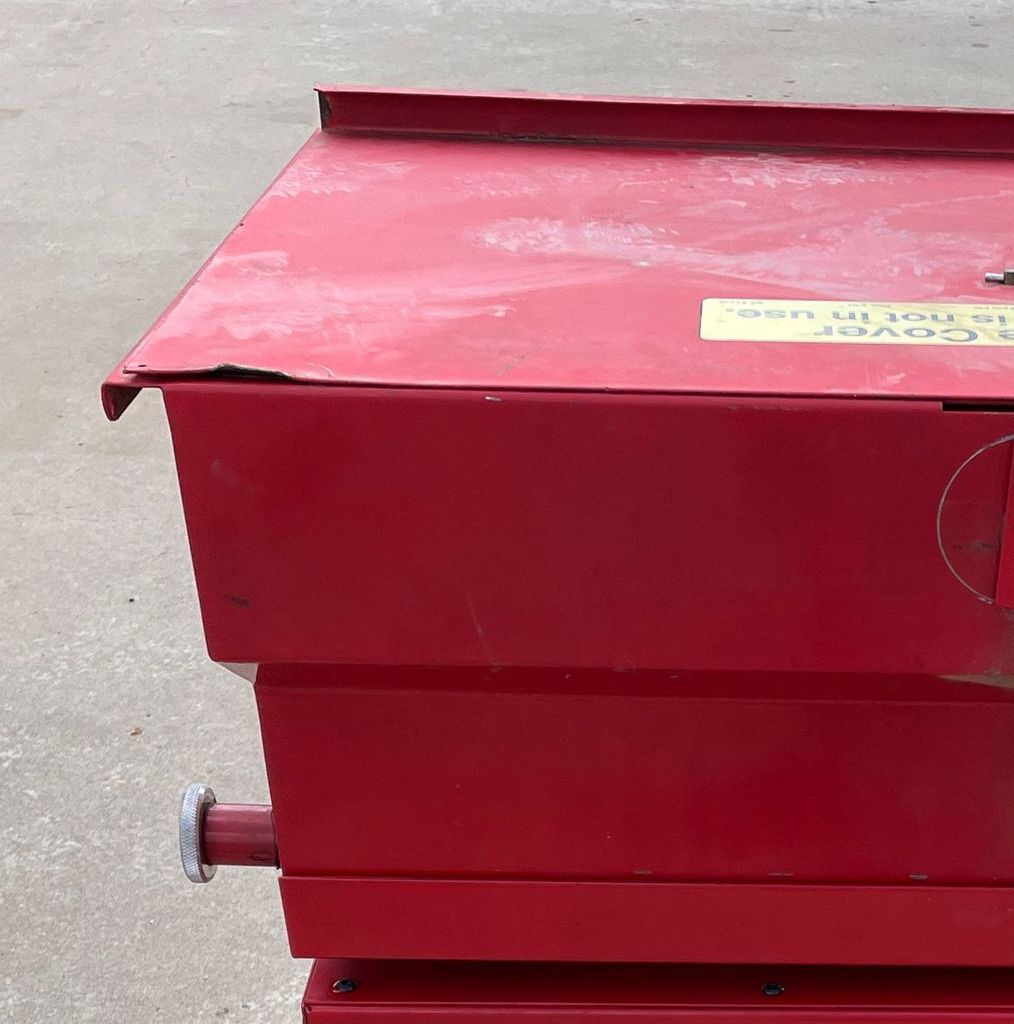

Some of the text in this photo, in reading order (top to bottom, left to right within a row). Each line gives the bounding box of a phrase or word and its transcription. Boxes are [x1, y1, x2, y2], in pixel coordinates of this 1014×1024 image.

[725, 308, 814, 320] use.
[832, 310, 870, 321] in
[887, 311, 955, 323] not
[972, 314, 1006, 325] is
[812, 325, 978, 342] Cover
